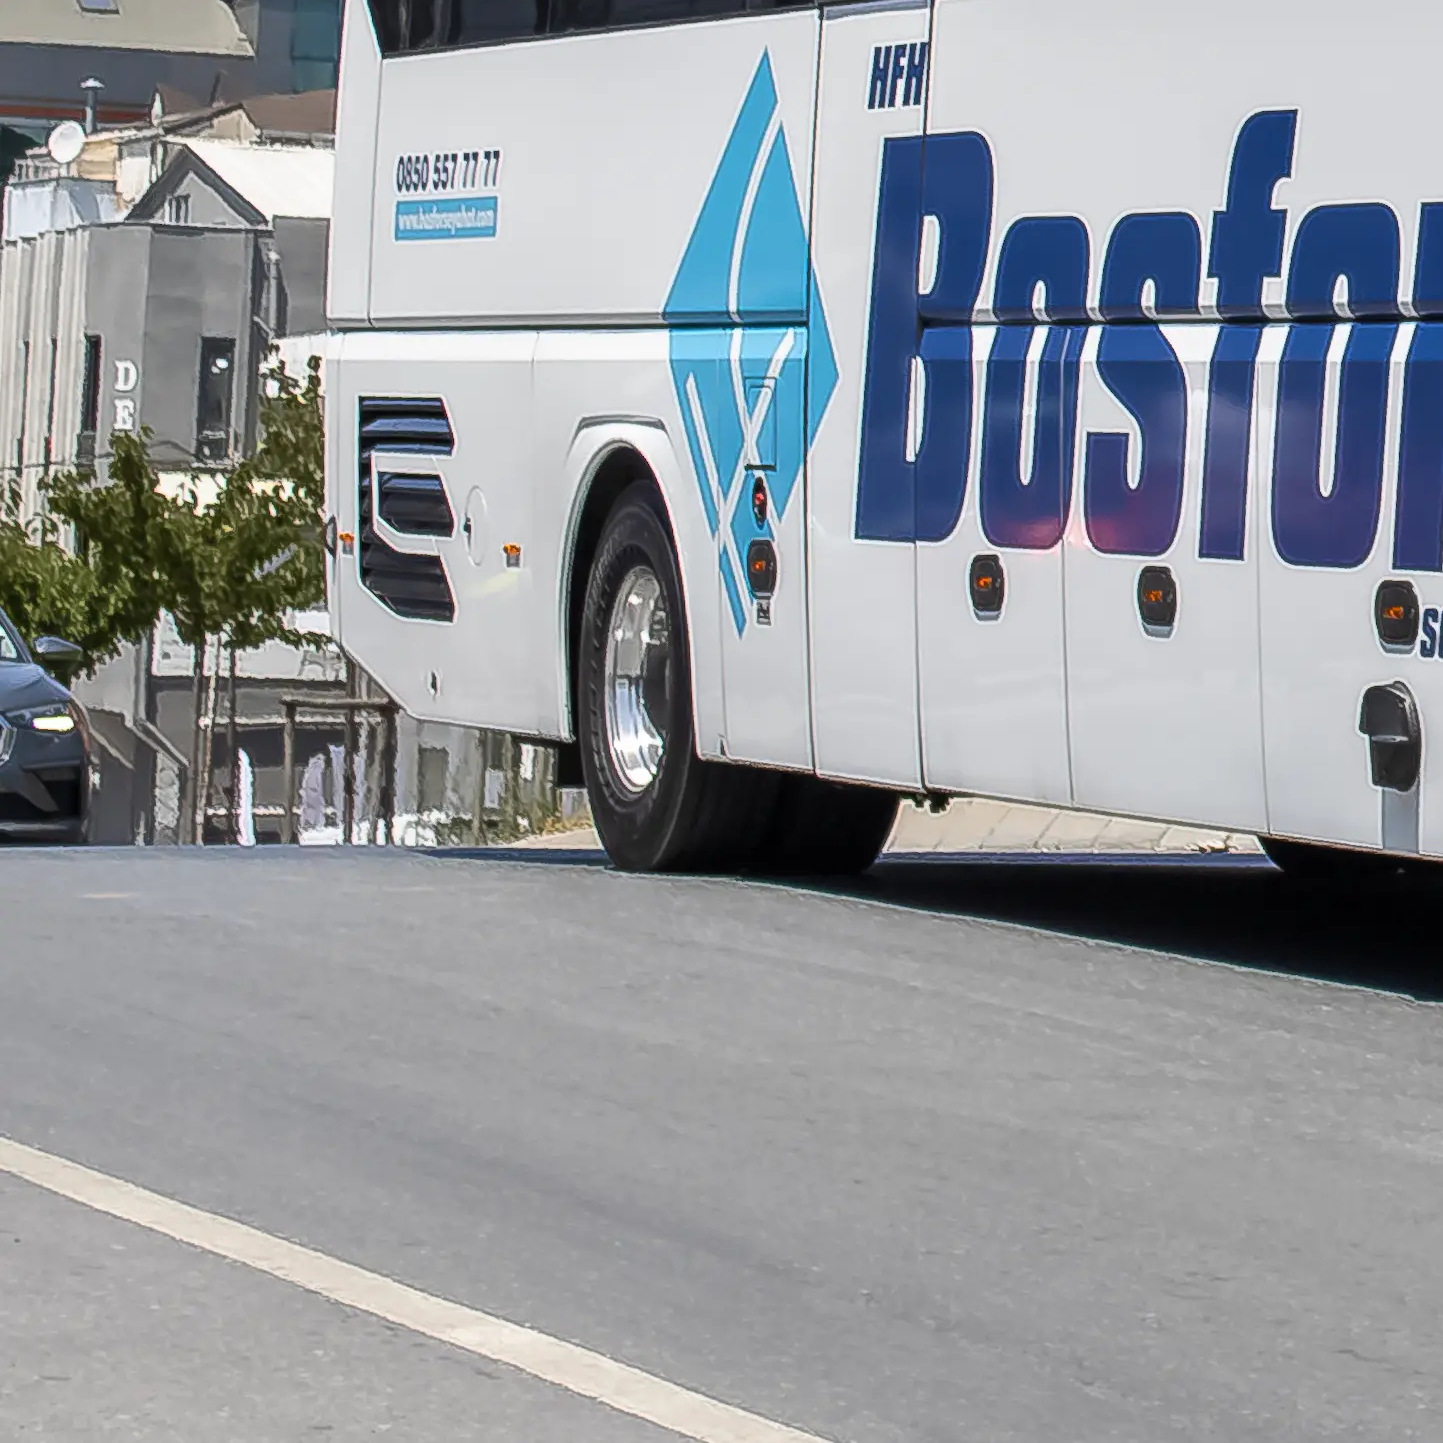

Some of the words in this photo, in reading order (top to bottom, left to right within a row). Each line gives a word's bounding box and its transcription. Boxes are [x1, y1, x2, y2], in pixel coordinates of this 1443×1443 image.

[867, 42, 928, 109] HFH
[396, 154, 430, 193] 0850
[432, 153, 459, 191] 557
[462, 151, 479, 189] 77
[482, 150, 500, 188] 77
